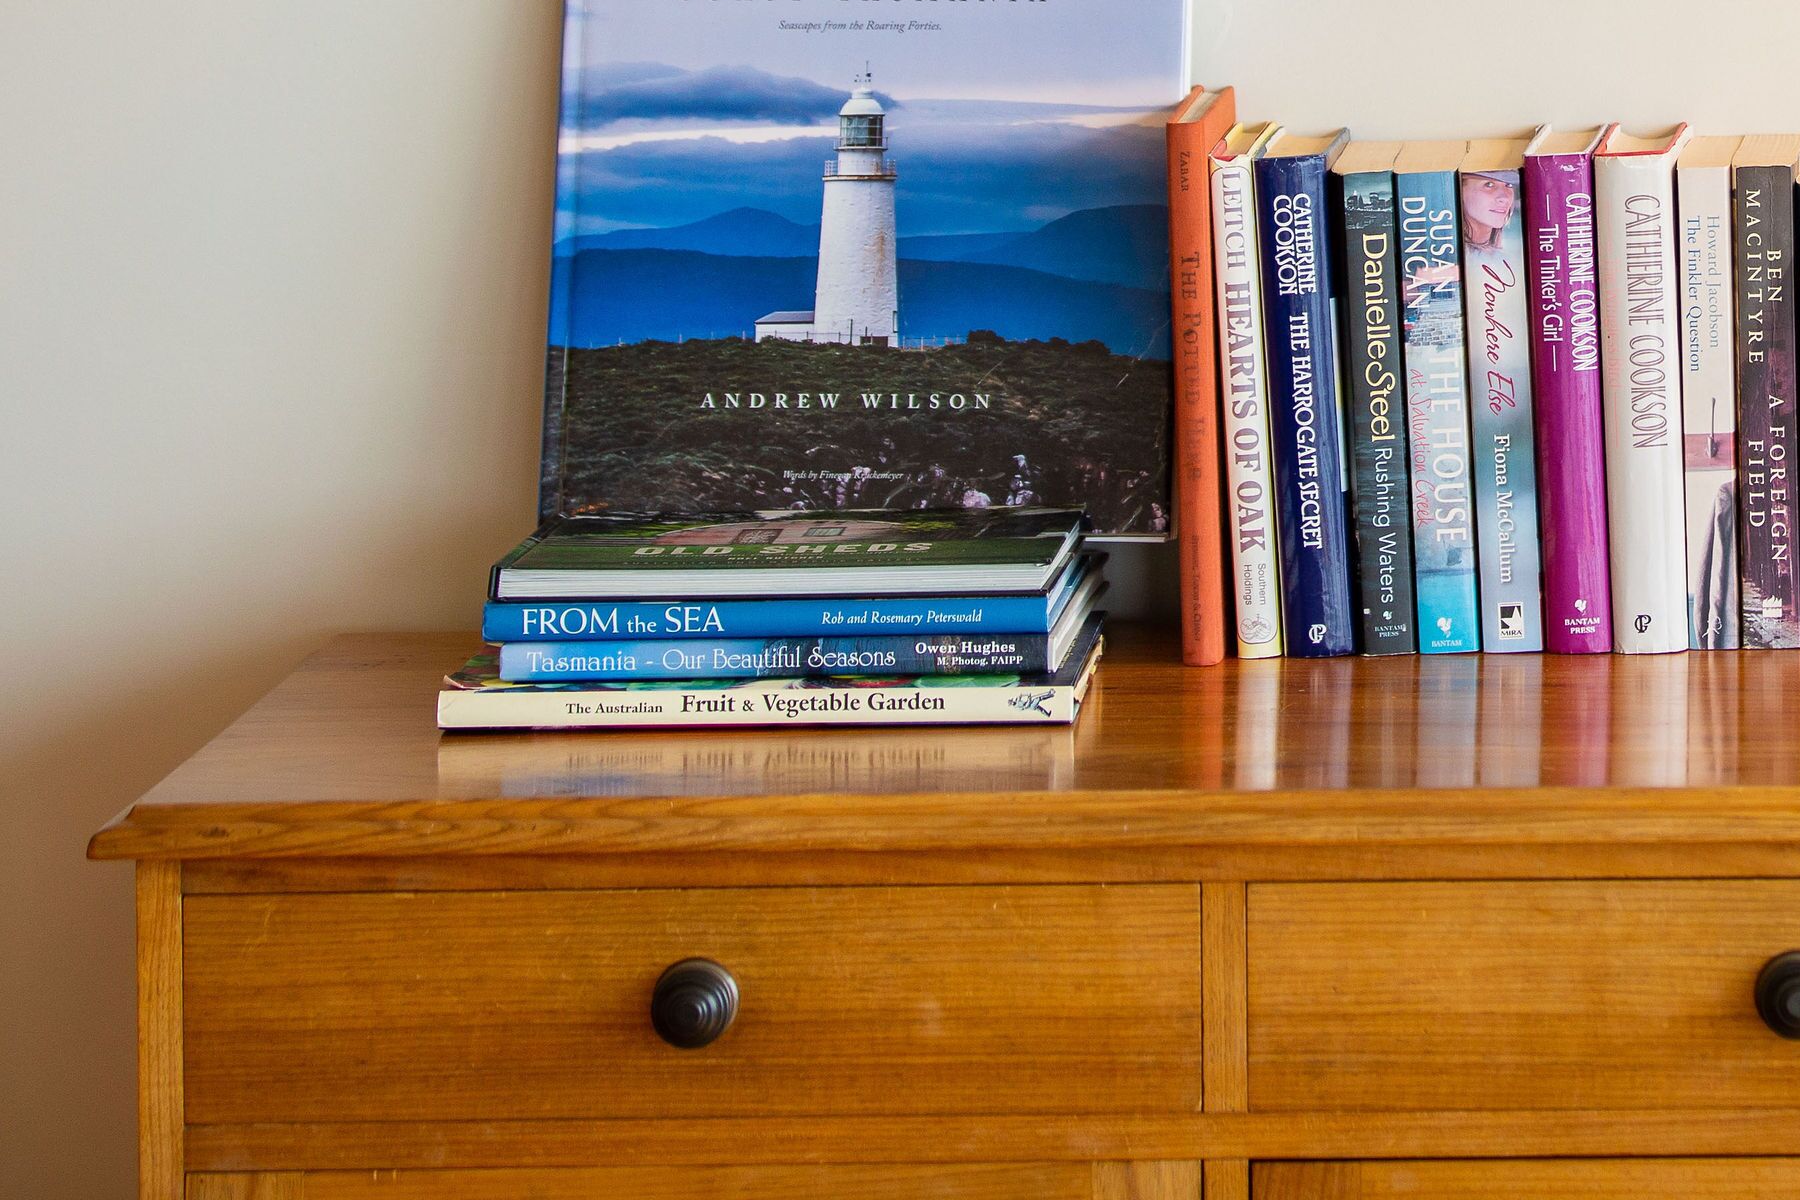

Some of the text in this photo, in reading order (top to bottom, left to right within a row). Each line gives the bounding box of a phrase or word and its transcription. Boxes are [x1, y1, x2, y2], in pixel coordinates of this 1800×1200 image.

[778, 19, 942, 33] Seascapes from the Roaring Forties.
[1273, 194, 1298, 296] COOKSON
[1292, 193, 1317, 295] CATHERINE
[1402, 196, 1428, 310] DUNCAN
[1428, 209, 1454, 294] SUSAN
[1538, 224, 1563, 342] The Tinker's Girl
[1566, 192, 1598, 371] CATHERINE COOKSON
[1686, 216, 1703, 372] The Finkler Question
[1705, 216, 1722, 349] Howard Jacobson
[1746, 189, 1764, 365] MACINTYRE
[1766, 250, 1782, 303] BEN
[1221, 172, 1265, 554] LEITCH HEARTS OF OAK
[1481, 259, 1516, 417] Nowhere Else
[1624, 194, 1668, 449] CATHERINE COOKSON
[700, 392, 991, 410] ANDREW WILSON
[1289, 312, 1322, 549] THE HARROGATE SECRET
[1362, 232, 1396, 604] Danielle Steel Rushing Waters
[1408, 368, 1435, 528] at Salvation Creek
[1429, 350, 1467, 543] THE HOUSE
[1493, 434, 1515, 584] Fiona McCallum
[1748, 439, 1765, 529] FIELD
[1768, 395, 1787, 562] A FOREIGN
[634, 543, 934, 555] OLD SHEDS
[1243, 564, 1252, 606] Holdings
[1257, 563, 1266, 606] Southern
[522, 607, 724, 634] FROM the SEA
[527, 646, 895, 672] Tasmania Our Beautiful Seasons
[821, 608, 982, 628] Rob and Rosemary Peterswald
[915, 641, 1015, 657] Owen Hughes
[565, 692, 945, 717] The Australian Fruit & Vegetable Garden
